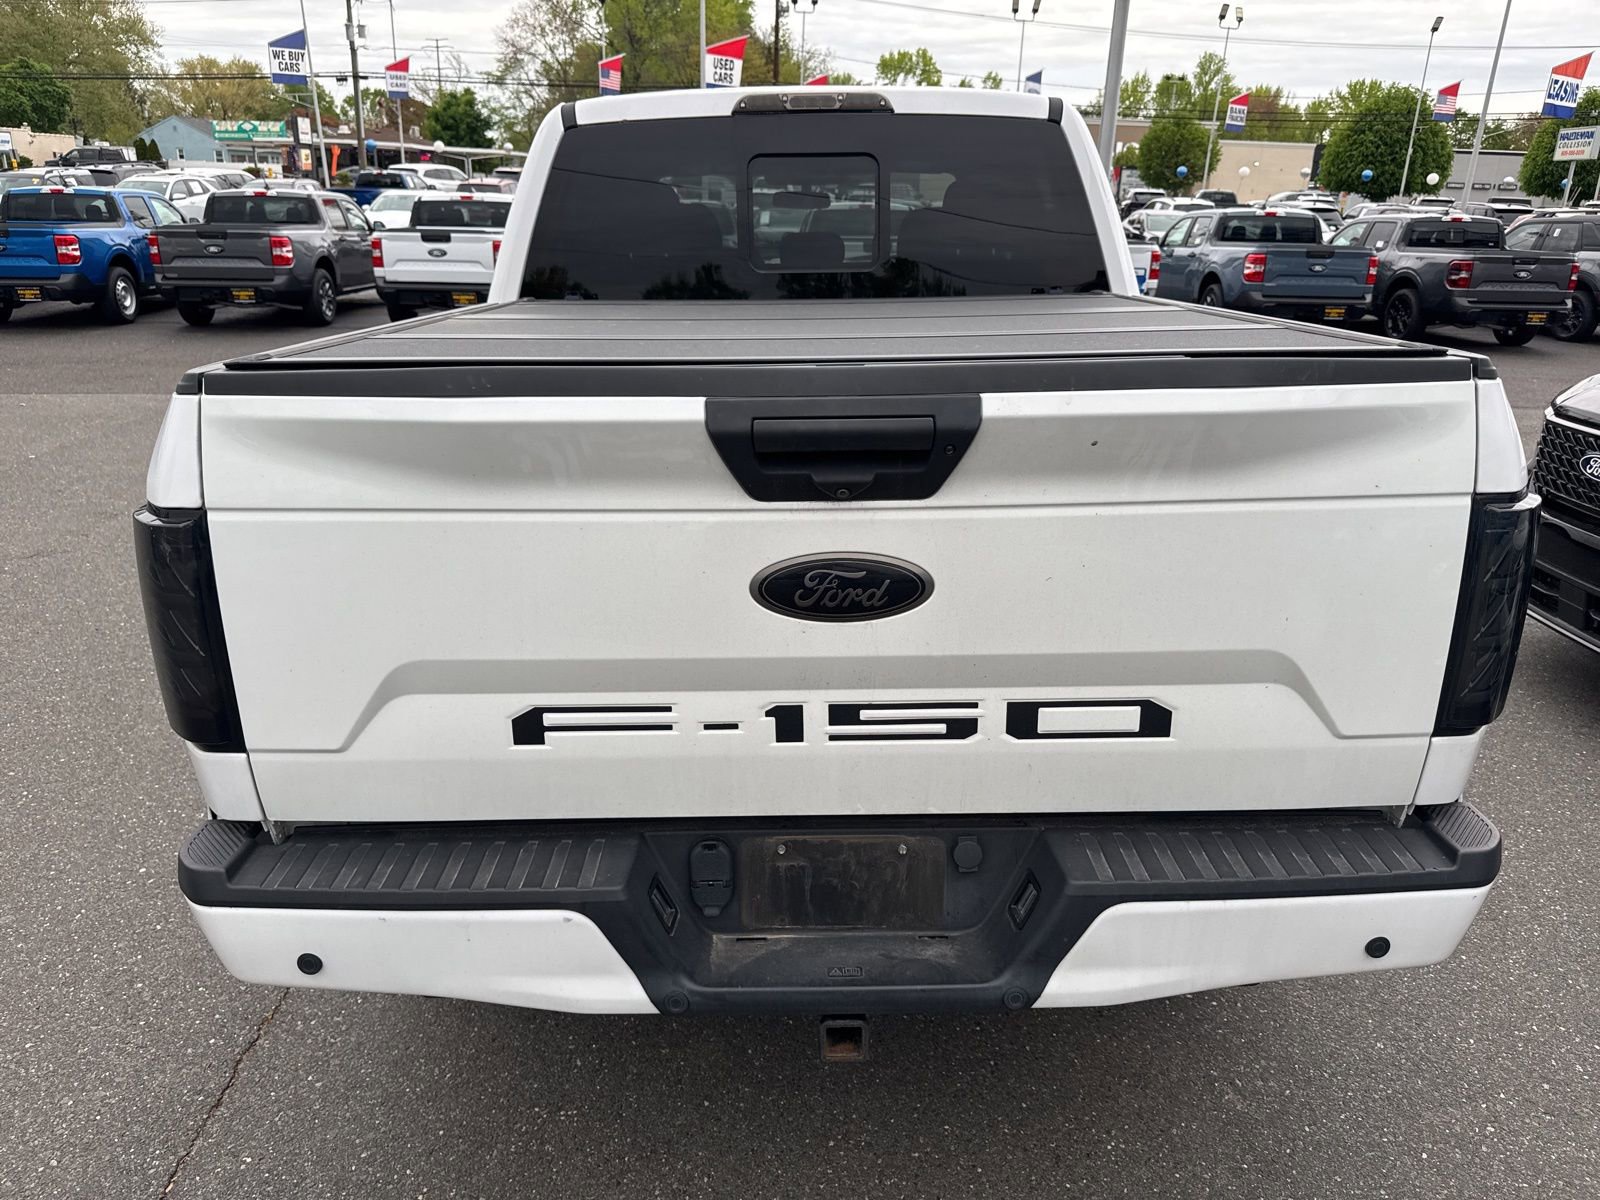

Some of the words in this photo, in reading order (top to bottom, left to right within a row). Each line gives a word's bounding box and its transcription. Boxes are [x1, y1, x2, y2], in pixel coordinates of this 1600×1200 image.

[271, 49, 287, 61] WE
[288, 52, 306, 63] BUY
[278, 61, 301, 73] CARS
[713, 57, 735, 71] USED
[713, 71, 734, 84] CARS
[1547, 78, 1579, 103] LEASING
[1558, 140, 1592, 149] COLLISION
[794, 569, 890, 608] Ford
[510, 699, 1174, 746] F-150
